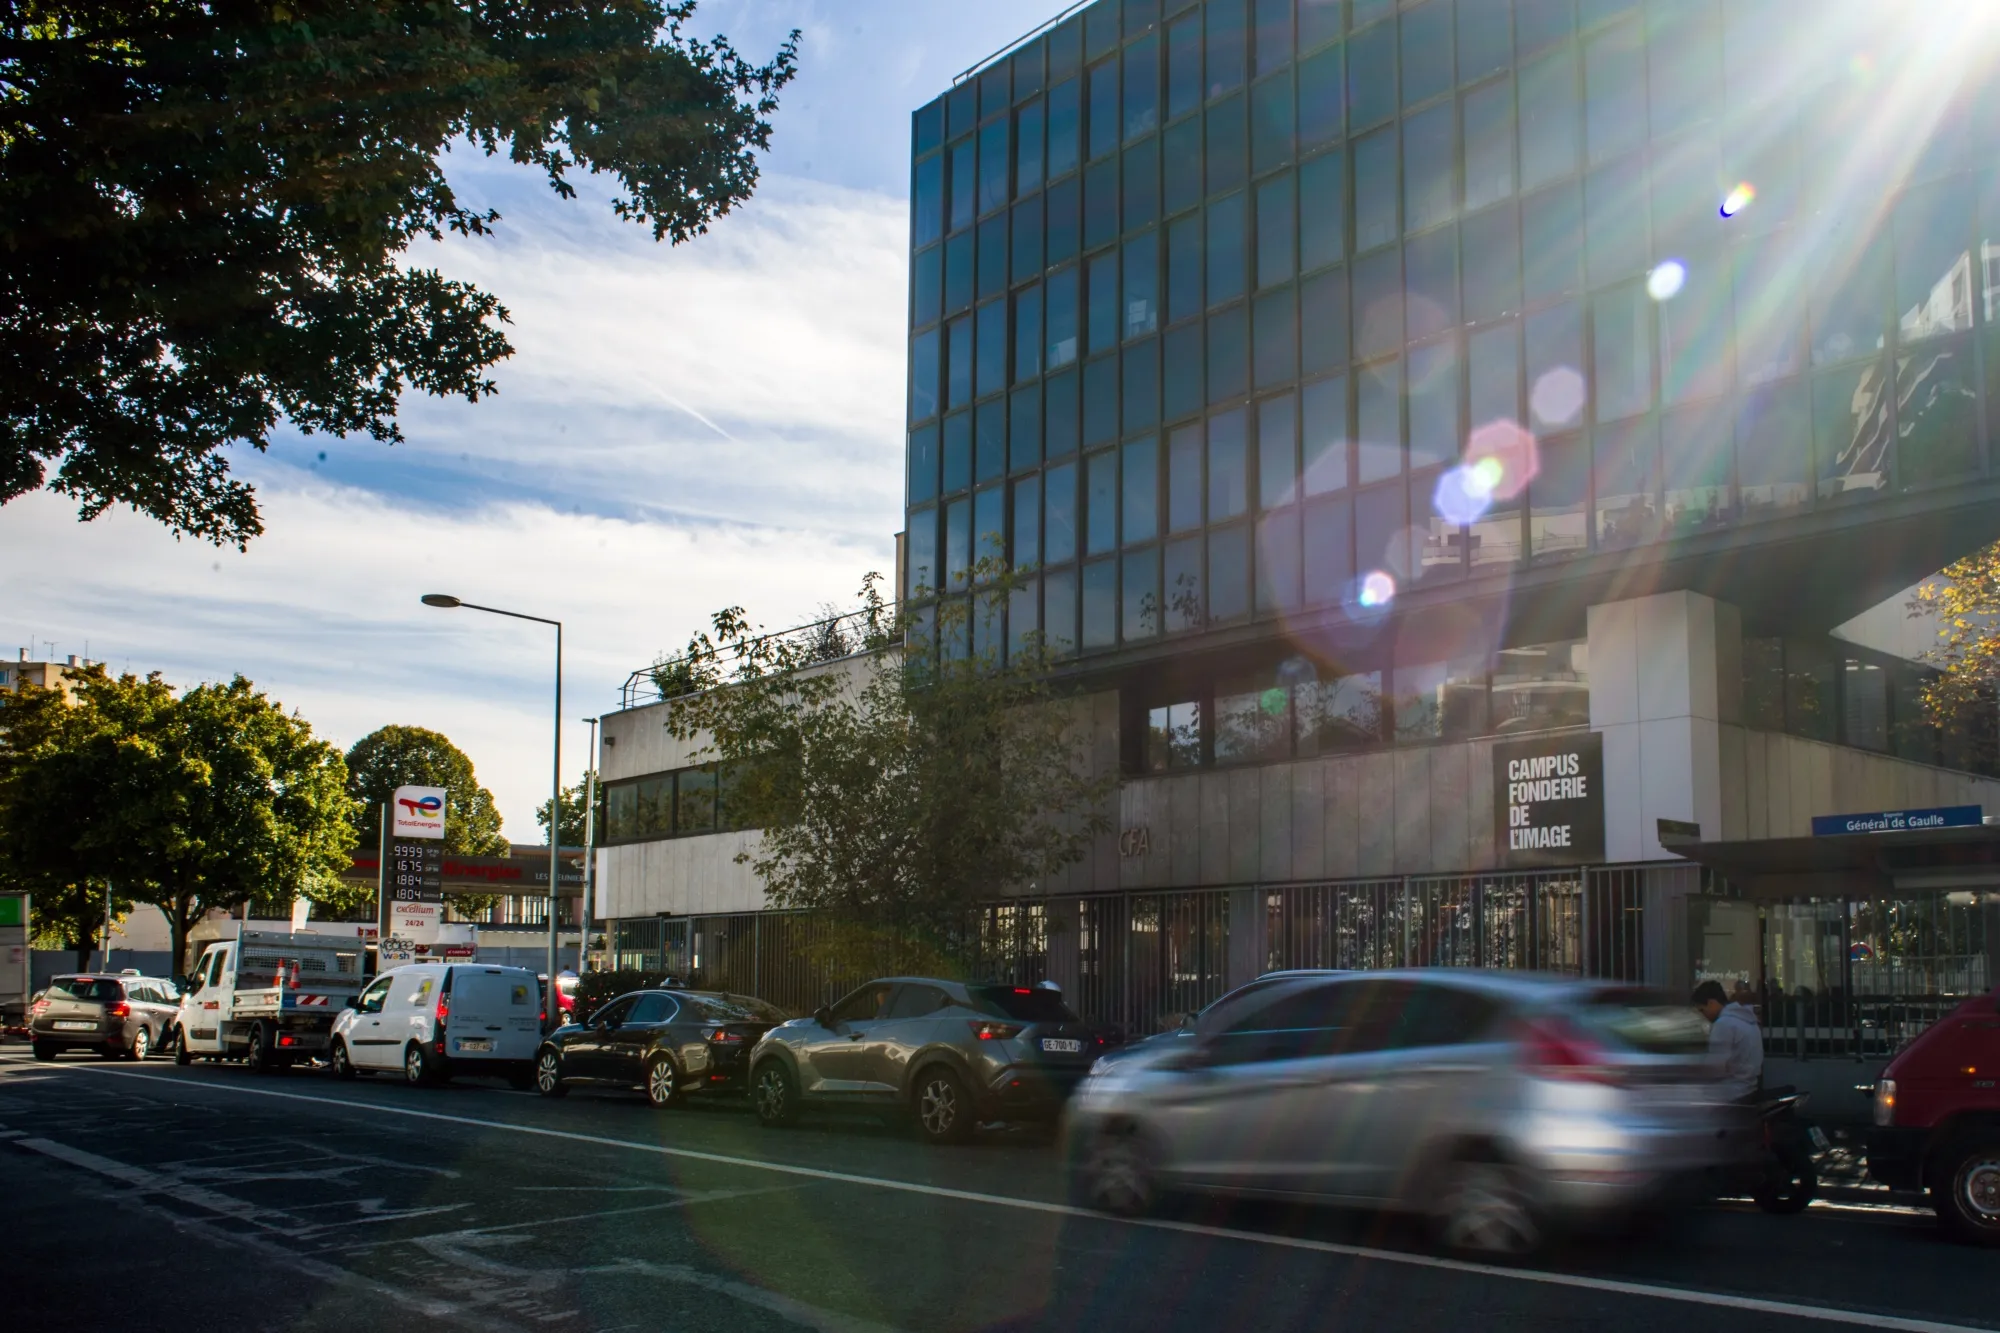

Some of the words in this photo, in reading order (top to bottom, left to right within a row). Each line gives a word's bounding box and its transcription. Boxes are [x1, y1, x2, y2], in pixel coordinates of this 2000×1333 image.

[1508, 753, 1580, 781] CAMPUS
[1508, 776, 1588, 804] FONDERIE
[397, 819, 442, 829] TotalEnergies
[1509, 805, 1530, 827] DE
[1846, 817, 1888, 831] Général
[1891, 817, 1905, 829] de
[1908, 814, 1944, 827] Gaulle
[1118, 828, 1151, 857] CFA
[1509, 825, 1571, 850] L'IMAGE
[535, 872, 549, 881] LES
[396, 903, 434, 915] excellium
[405, 919, 425, 927] 24/24
[383, 951, 410, 961] wash
